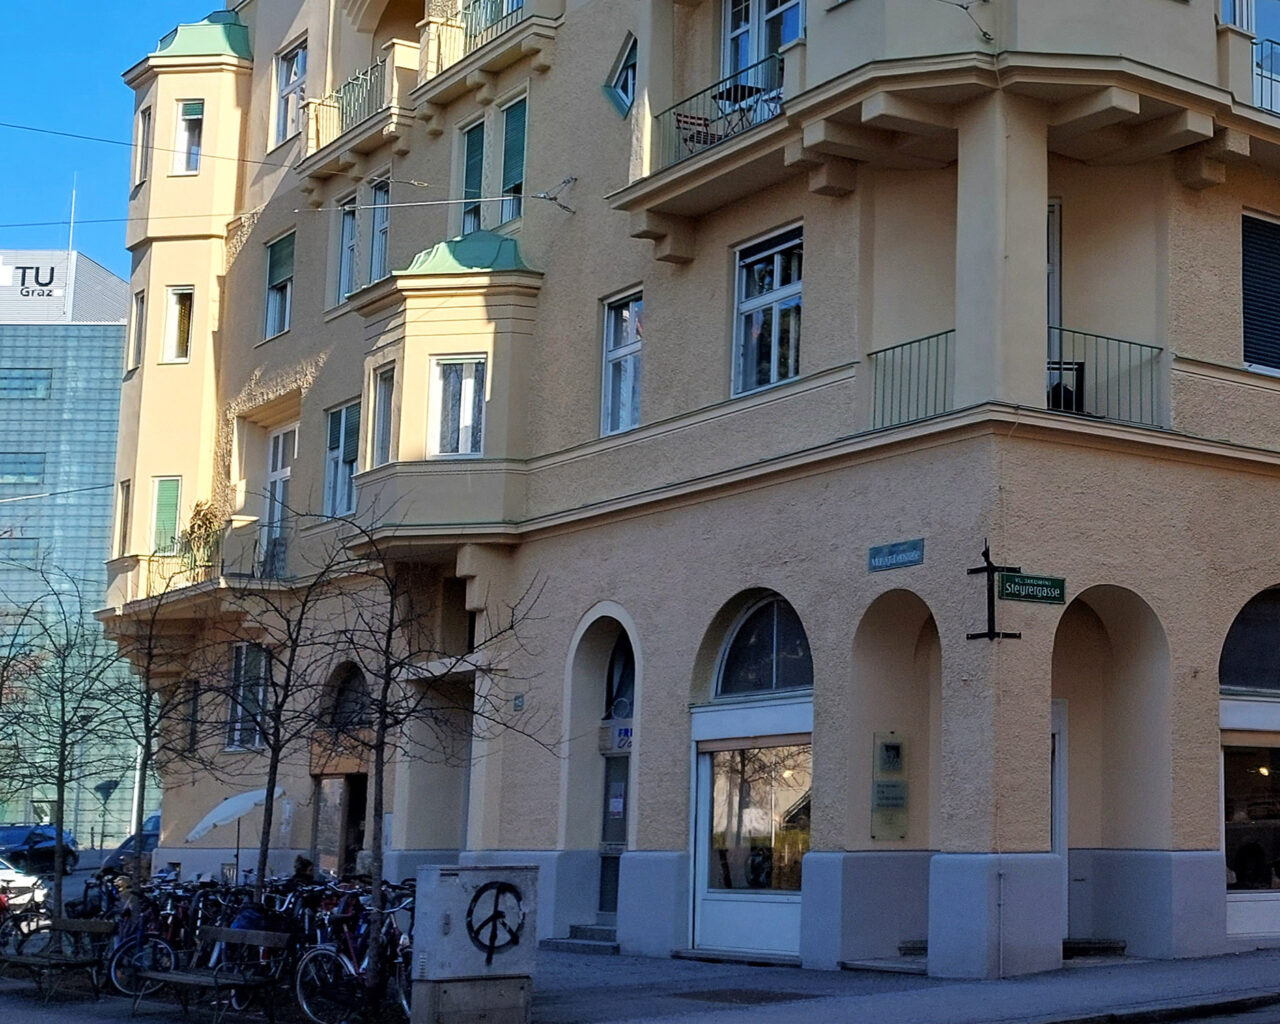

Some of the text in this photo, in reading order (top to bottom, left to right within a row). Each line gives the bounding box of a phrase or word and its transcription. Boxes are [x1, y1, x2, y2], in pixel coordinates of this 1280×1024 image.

[15, 266, 55, 287] TU
[20, 286, 53, 297] Graz
[1005, 582, 1060, 598] Steyrergasse
